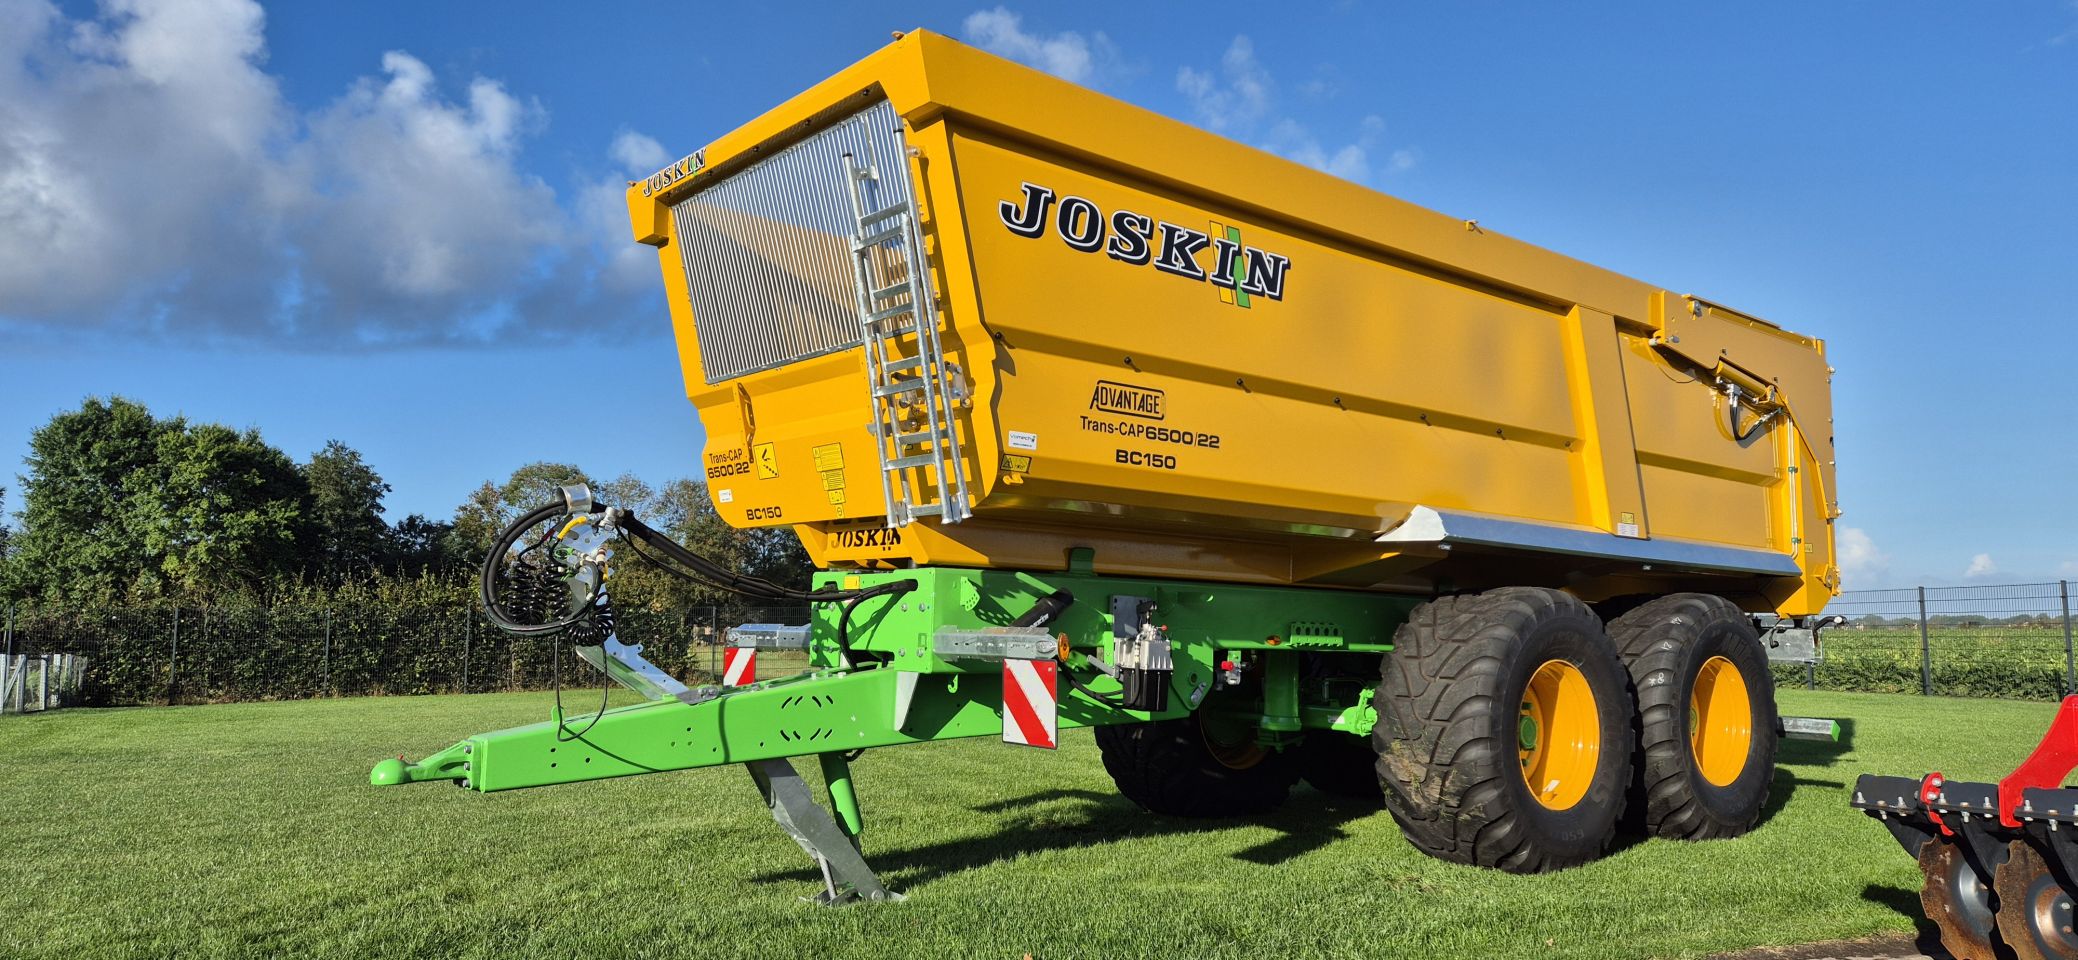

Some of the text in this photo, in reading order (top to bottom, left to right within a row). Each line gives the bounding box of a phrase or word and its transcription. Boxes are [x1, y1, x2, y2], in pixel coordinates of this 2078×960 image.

[643, 147, 707, 197] JOSKIN
[998, 181, 1291, 301] JOSKIN
[1089, 385, 1161, 415] ADVANTAGE
[709, 448, 743, 464] Trans-CAP
[1115, 449, 1176, 470] BC150
[746, 506, 782, 520] BC150
[831, 527, 901, 549] JOSKIN
